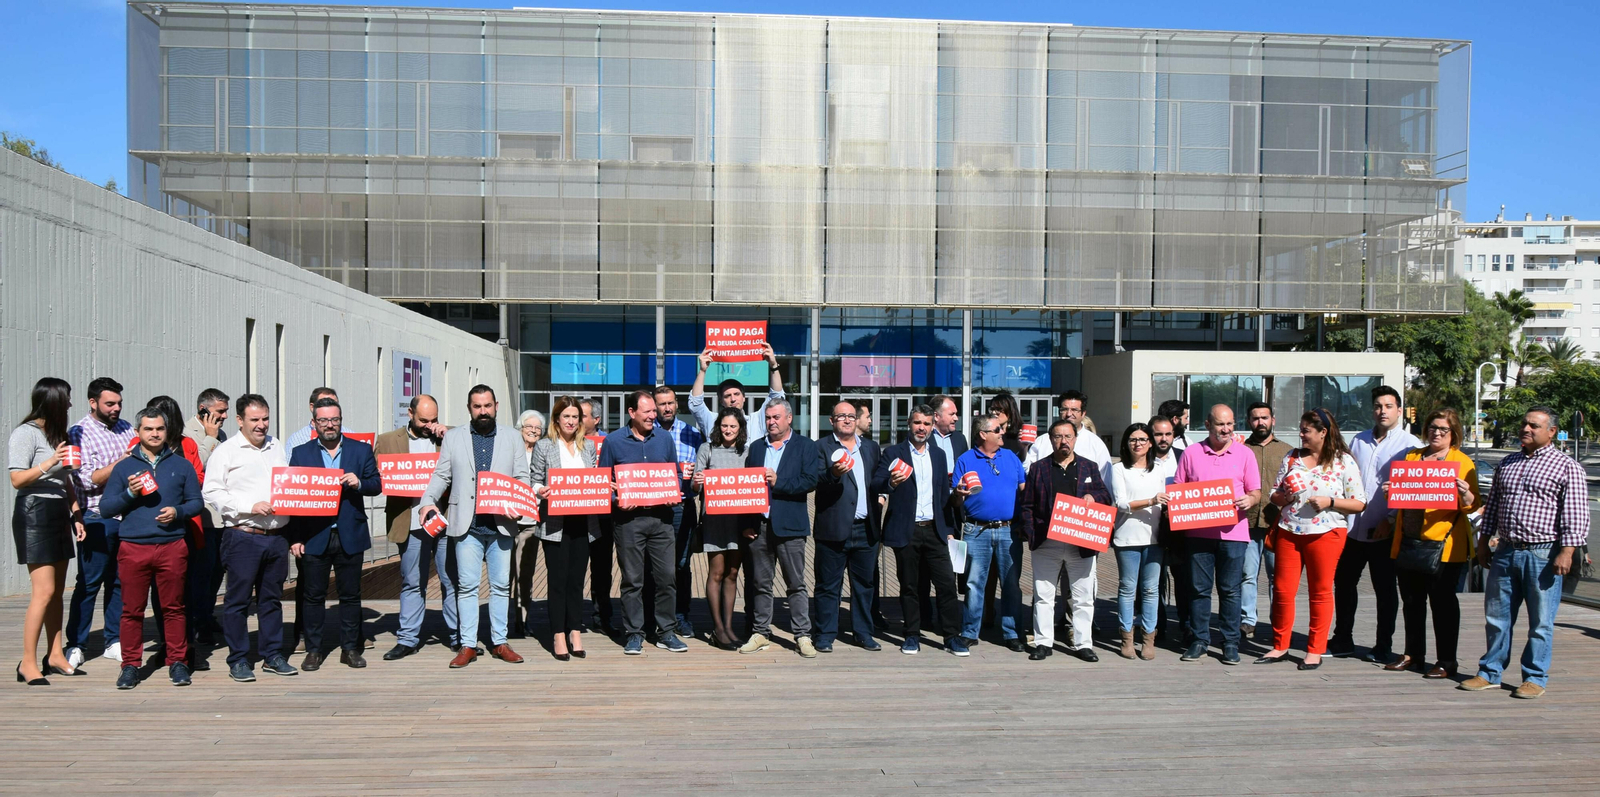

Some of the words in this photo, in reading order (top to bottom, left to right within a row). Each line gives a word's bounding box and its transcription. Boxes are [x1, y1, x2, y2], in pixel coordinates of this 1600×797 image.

[708, 328, 720, 336] PP
[723, 328, 737, 336] NO
[740, 327, 764, 336] PAGA
[381, 461, 394, 470] PP
[397, 461, 412, 470] NO
[415, 460, 439, 469] PAG
[618, 471, 630, 479] PP
[632, 470, 647, 478] NO
[650, 469, 675, 478] PAGA
[1391, 468, 1405, 477] PP
[1408, 468, 1423, 477] NO
[1426, 468, 1456, 477] PAGA
[274, 474, 289, 483] PP
[292, 475, 308, 484] NO
[312, 475, 340, 486] PAGA
[551, 476, 563, 485] PP
[566, 475, 581, 484] NO
[583, 475, 609, 484] PAGA
[705, 476, 718, 485] PP
[721, 476, 735, 485] NO
[738, 474, 765, 484] PAGA
[284, 488, 308, 496] DEUDA
[480, 478, 494, 486] PP
[496, 479, 511, 488] NO
[513, 483, 536, 499] PAGA
[1169, 491, 1182, 500] PP
[1184, 489, 1200, 499] NO
[1203, 486, 1232, 497] PAGA
[513, 493, 526, 501] CON
[621, 490, 678, 499] AYUNTAMIENTOS
[1390, 493, 1454, 502] AYUNTAMIENTOS
[273, 500, 337, 509] AYUNTAMIENTOS
[551, 499, 609, 508] AYUNTAMIENTOS
[708, 498, 766, 507] AYUNTAMIENTOS
[1056, 501, 1069, 511] PP
[1071, 504, 1086, 515] NO
[1087, 509, 1112, 523] PAGA
[1172, 510, 1235, 524] AYUNTAMIENTOS
[1064, 516, 1083, 526] DEUDA
[1084, 522, 1097, 530] CON
[1098, 525, 1110, 533] LOS
[1052, 525, 1107, 544] AYUNTAMIENTOS
